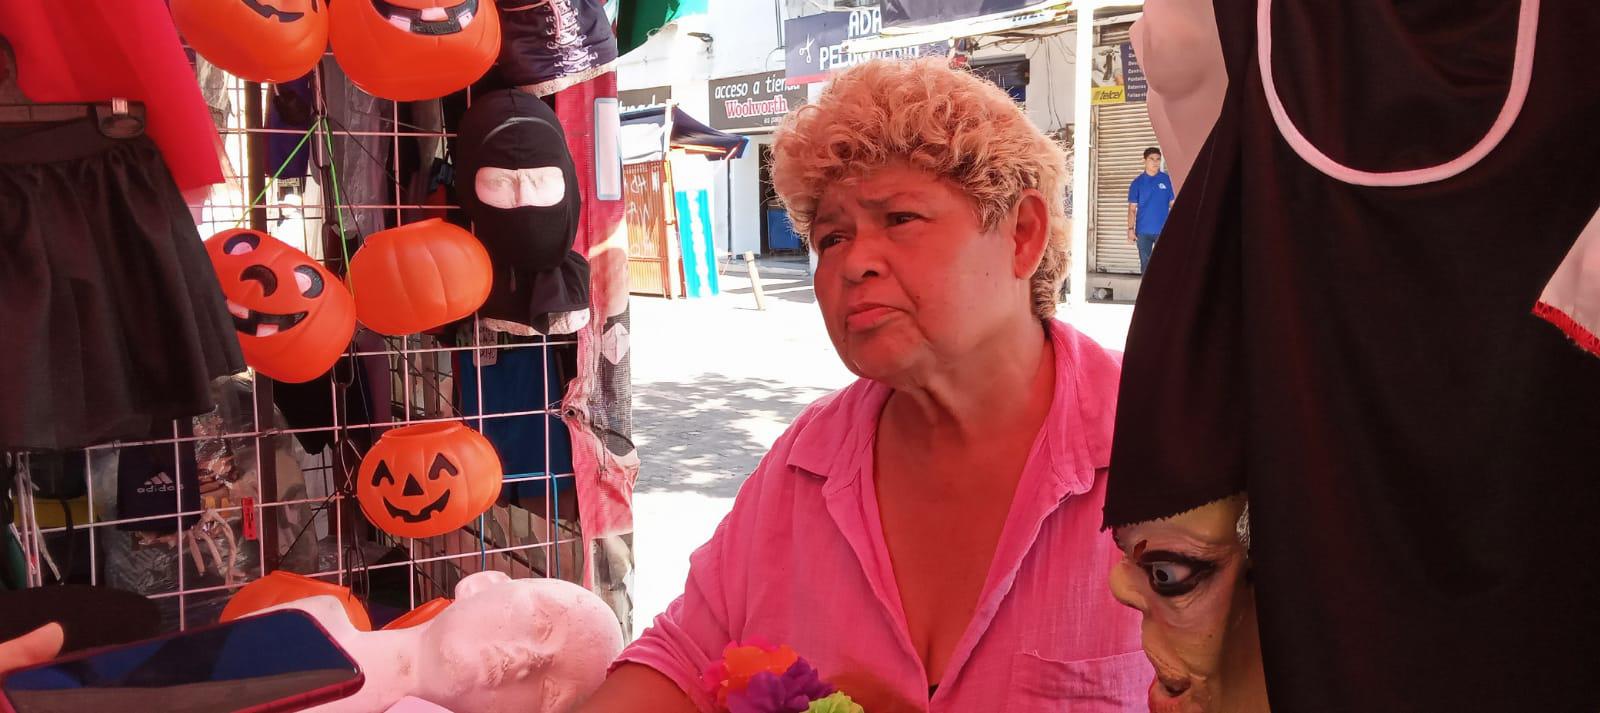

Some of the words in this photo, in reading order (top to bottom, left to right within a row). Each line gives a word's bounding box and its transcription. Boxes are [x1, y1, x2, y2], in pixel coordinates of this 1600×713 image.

[715, 83, 748, 99] acceso
[753, 81, 760, 95] a
[725, 95, 788, 118] Woolworth
[136, 483, 184, 494] adidas
